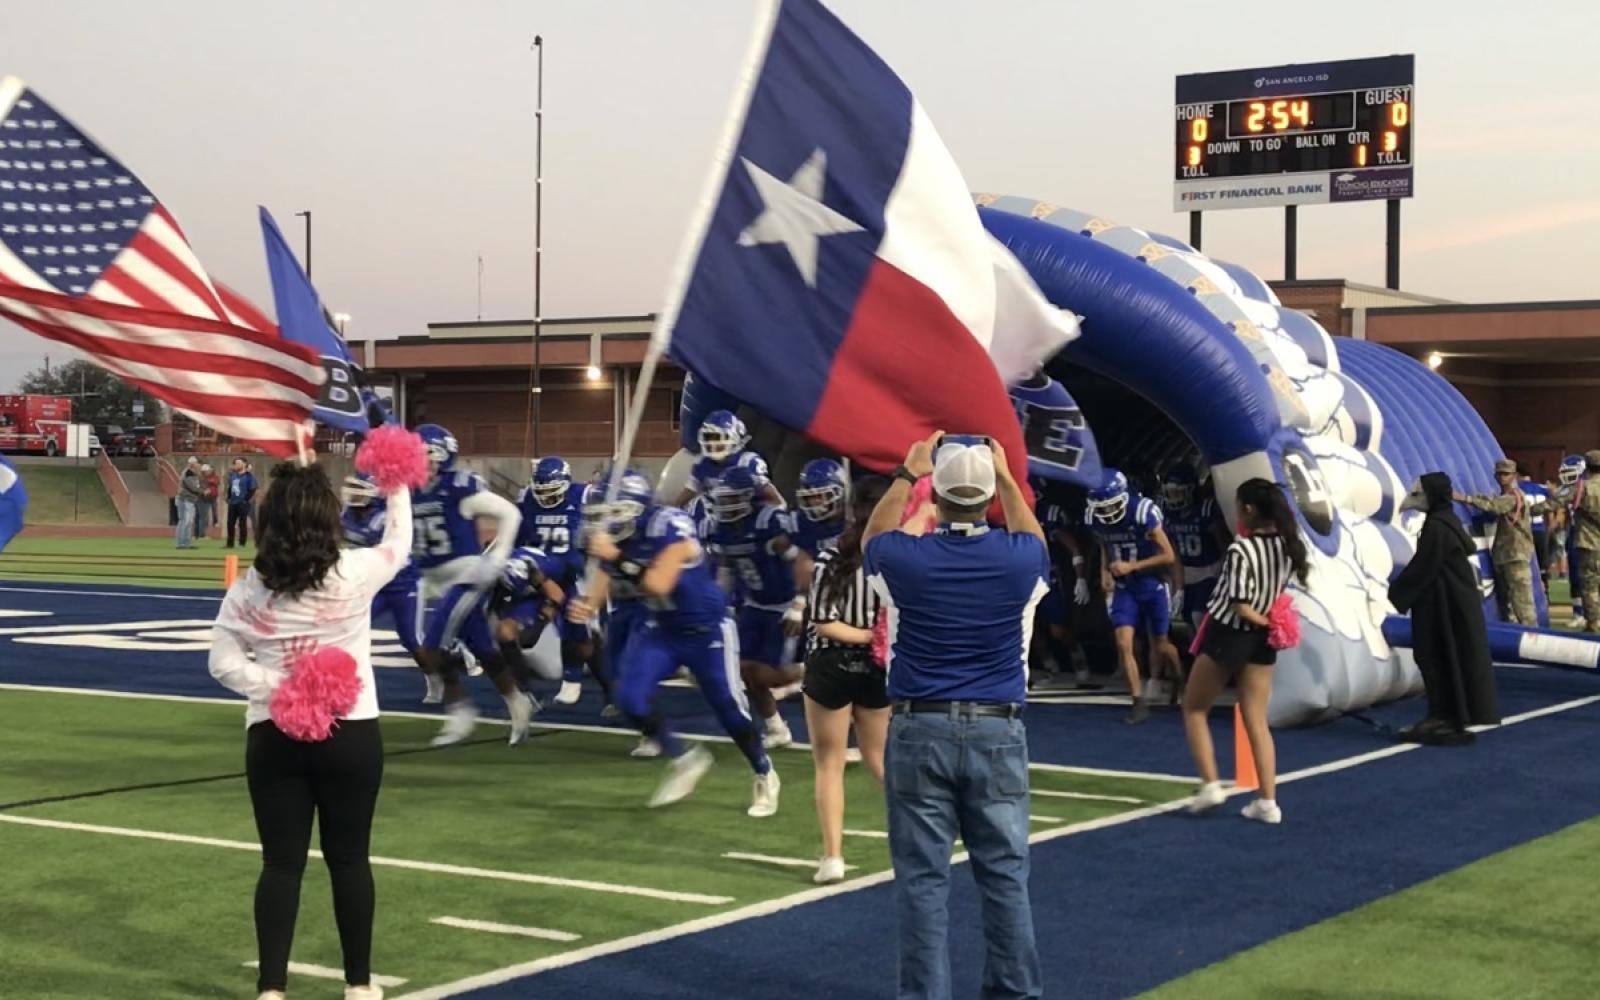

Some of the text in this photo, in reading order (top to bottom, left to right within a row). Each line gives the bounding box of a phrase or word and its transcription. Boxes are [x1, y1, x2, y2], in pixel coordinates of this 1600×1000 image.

[1265, 74, 1329, 86] SAN ANGELO ISD
[1365, 88, 1410, 106] GUEST
[1176, 104, 1214, 121] HOME
[1248, 100, 1309, 132] 2:54
[1392, 102, 1407, 127] 0
[1192, 118, 1208, 142] 0
[1348, 131, 1370, 145] QTR
[1207, 141, 1241, 155] DOWN
[1250, 138, 1281, 151] TO GO
[1296, 134, 1336, 149] BALL ON
[1384, 131, 1397, 152] 3
[1189, 146, 1201, 165] 3
[1359, 144, 1366, 166] 1
[1377, 151, 1407, 164] T.O.L.
[1182, 165, 1209, 178] T.O.L.
[1181, 184, 1324, 202] FIRST FINANCIAL BANK
[1022, 401, 1086, 471] E
